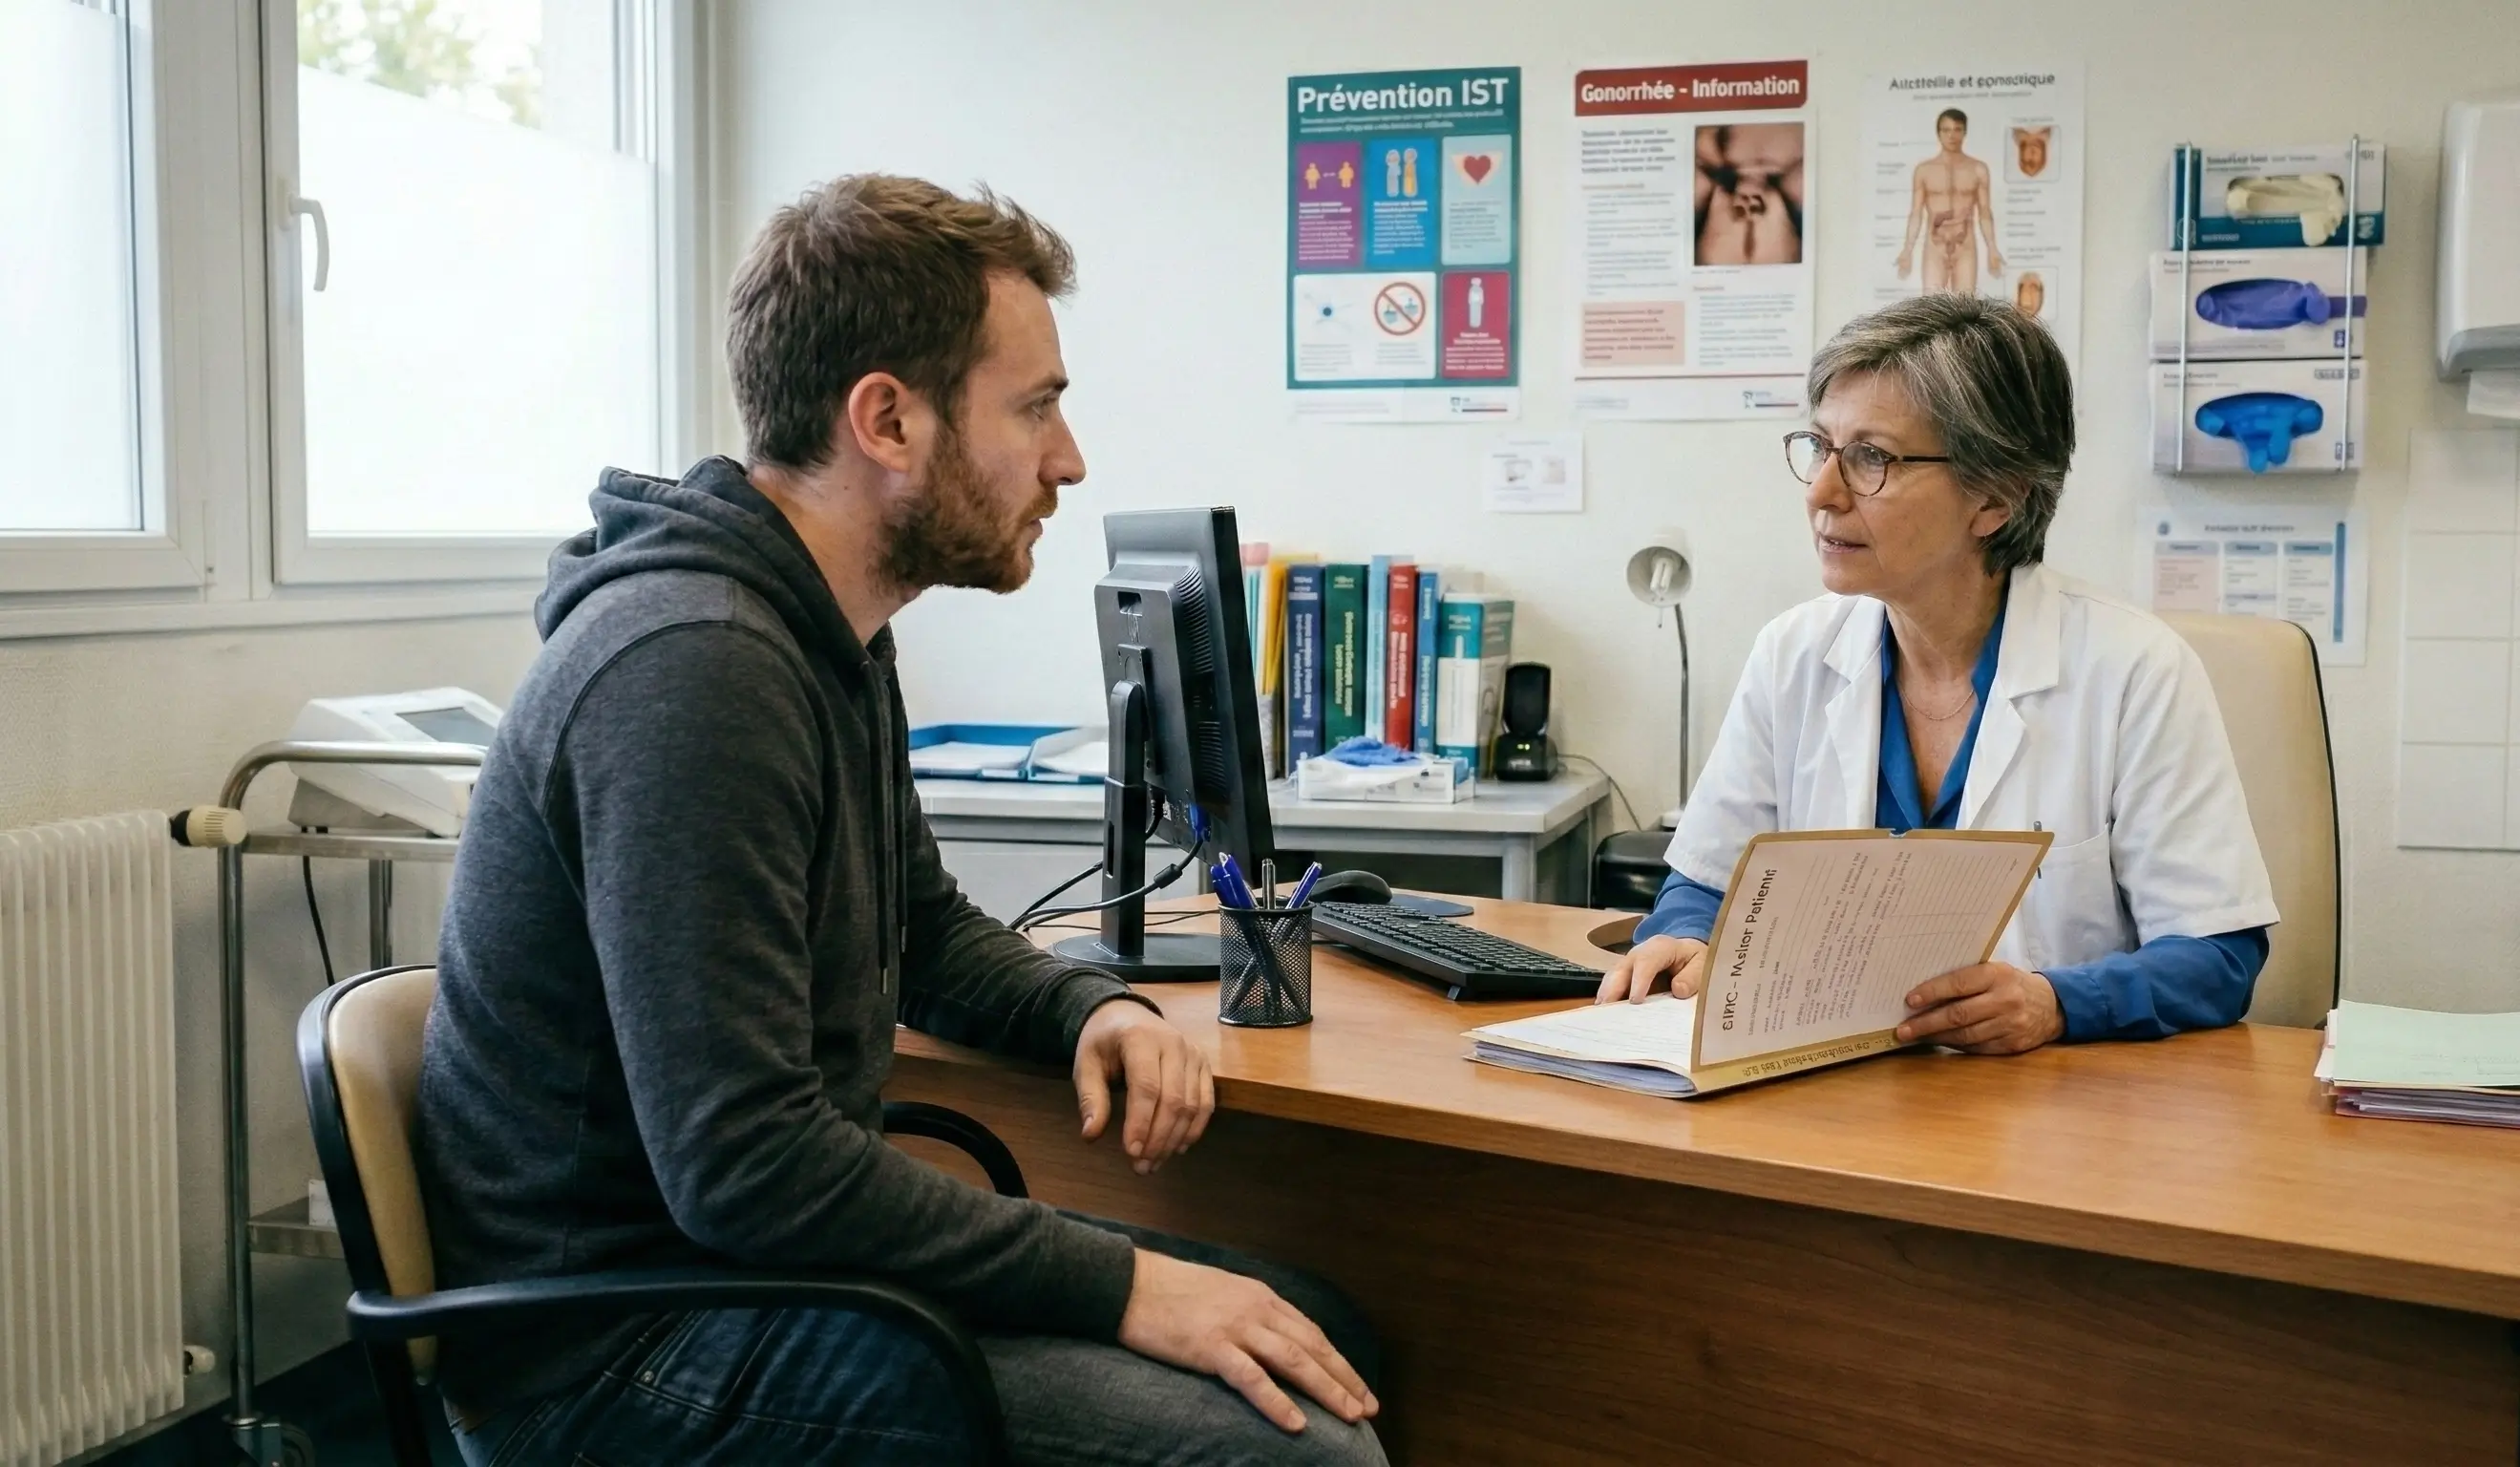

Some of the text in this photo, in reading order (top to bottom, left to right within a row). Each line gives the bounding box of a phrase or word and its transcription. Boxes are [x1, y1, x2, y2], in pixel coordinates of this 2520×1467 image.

[1297, 77, 1509, 113] Prévention IST
[1581, 79, 1675, 102] Gonorrhée
[1692, 75, 1800, 98] Information
[1959, 75, 1973, 89] et
